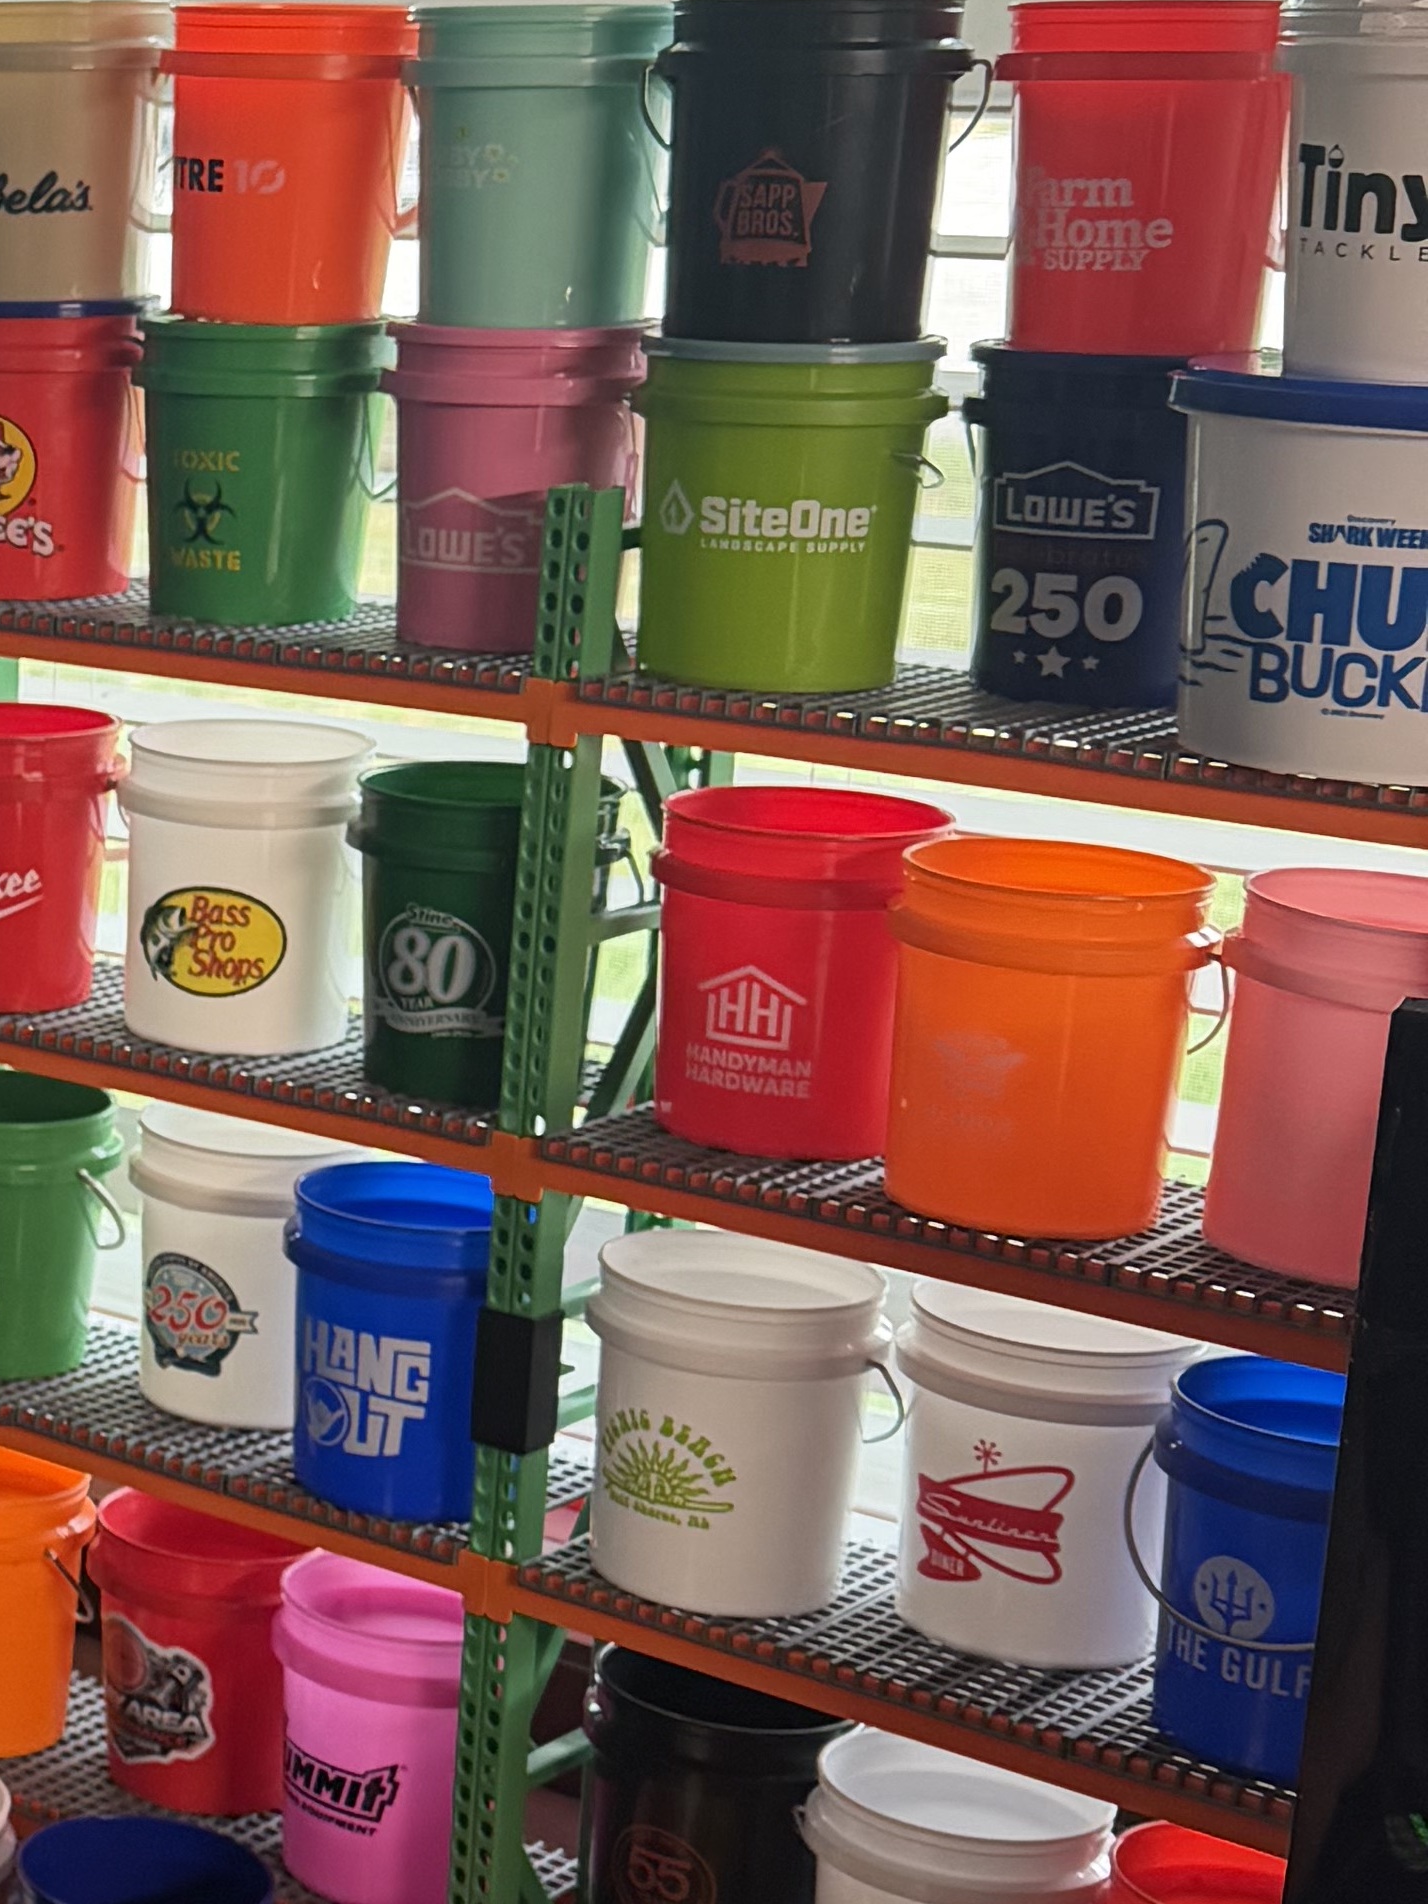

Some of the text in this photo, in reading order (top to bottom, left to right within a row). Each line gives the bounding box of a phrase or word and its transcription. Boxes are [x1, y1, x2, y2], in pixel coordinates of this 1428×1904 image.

[1037, 206, 1174, 249] Home
[1044, 248, 1150, 272] SUPPLY
[699, 496, 871, 539] SiteOne
[1006, 486, 1138, 530] LOWE'S
[700, 538, 866, 554] LANDSCAPE SUPPLY
[1308, 522, 1374, 548] SHARK
[990, 567, 1143, 642] 250
[1230, 551, 1428, 652] CHU
[188, 894, 252, 928] Bass
[188, 924, 237, 953] Pro
[187, 949, 266, 987] Shops
[387, 926, 477, 1004] 80
[685, 1042, 812, 1079] HANDYMAN
[685, 1062, 812, 1100] HARDWARE
[1166, 1614, 1208, 1672] THE
